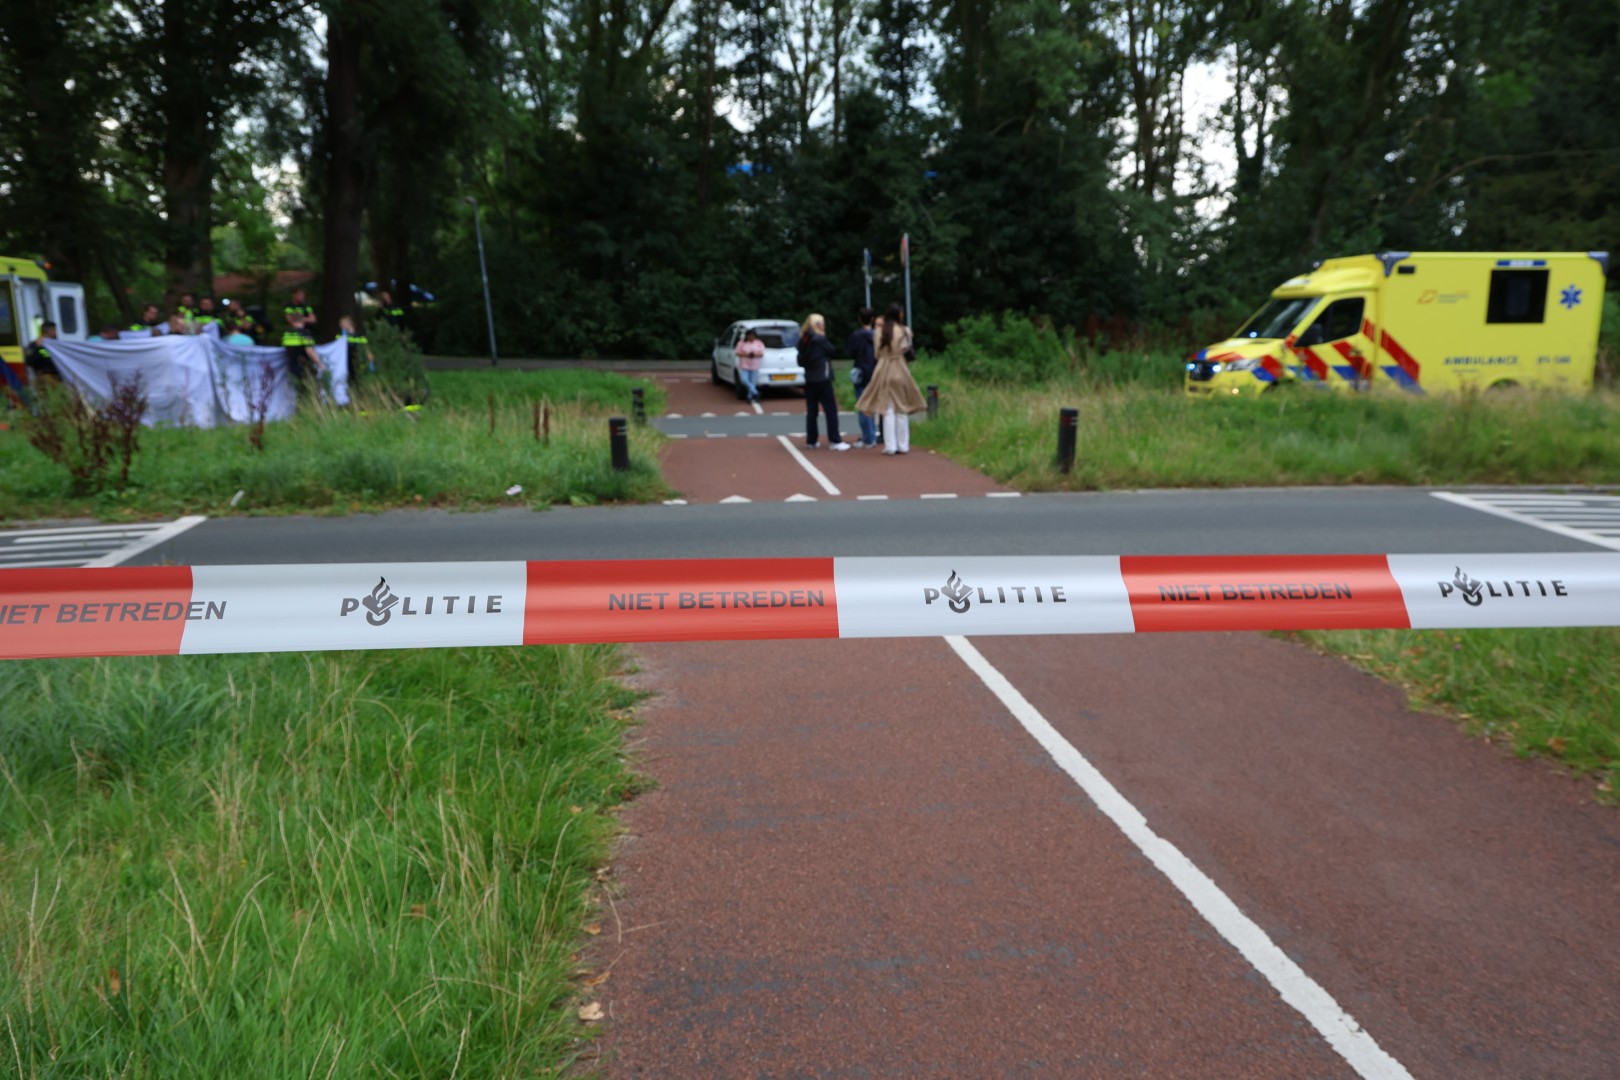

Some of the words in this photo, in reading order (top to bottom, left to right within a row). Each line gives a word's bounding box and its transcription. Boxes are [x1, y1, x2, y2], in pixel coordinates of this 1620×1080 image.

[1444, 355, 1518, 365] AMBULANCE
[609, 593, 670, 611] NIET
[678, 590, 825, 609] BETREDEN
[923, 577, 1067, 613] POLITIE
[1158, 584, 1212, 602] NIET
[1222, 582, 1353, 600] BETREDEN
[1437, 572, 1569, 606] POLITIE
[0, 604, 50, 625] IET
[56, 600, 227, 623] BETREDEN
[340, 584, 503, 626] POLITIE
